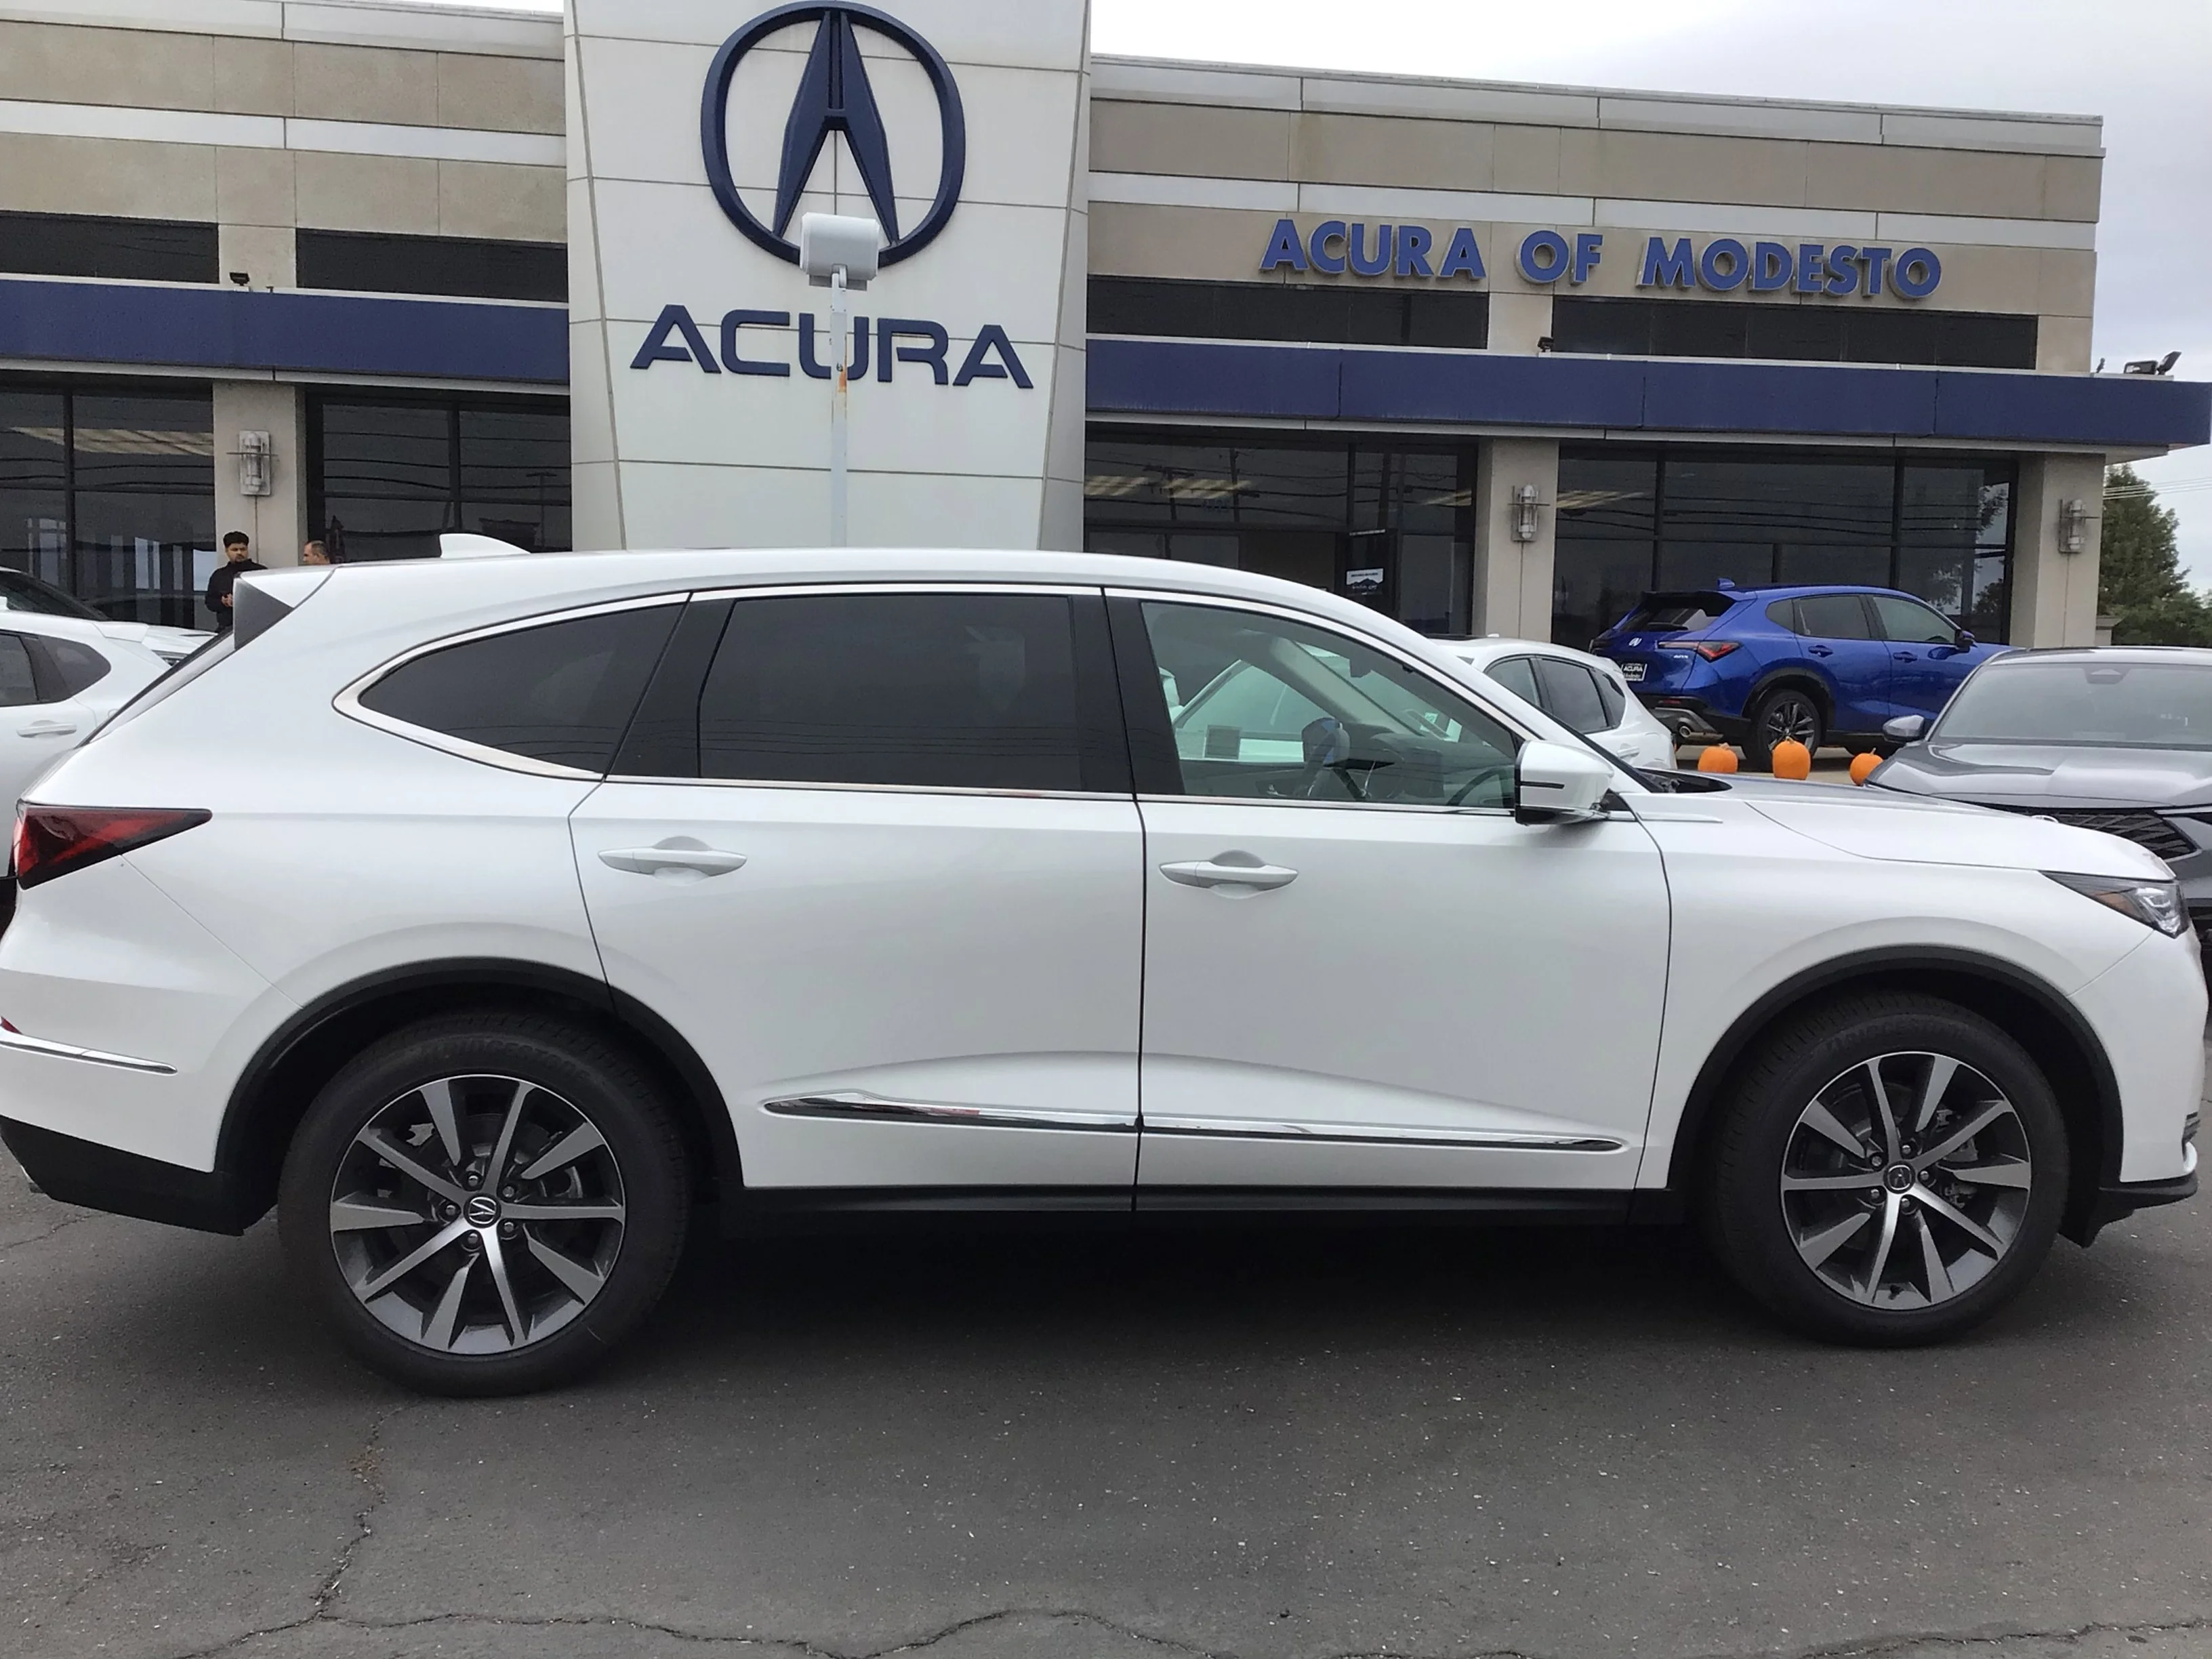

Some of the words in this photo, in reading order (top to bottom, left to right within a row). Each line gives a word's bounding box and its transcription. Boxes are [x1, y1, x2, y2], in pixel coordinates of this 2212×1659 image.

[1260, 218, 1487, 279] ACURA
[1517, 229, 1603, 285] OF
[1636, 236, 1942, 299] MODESTO
[630, 304, 1034, 389] ACURA
